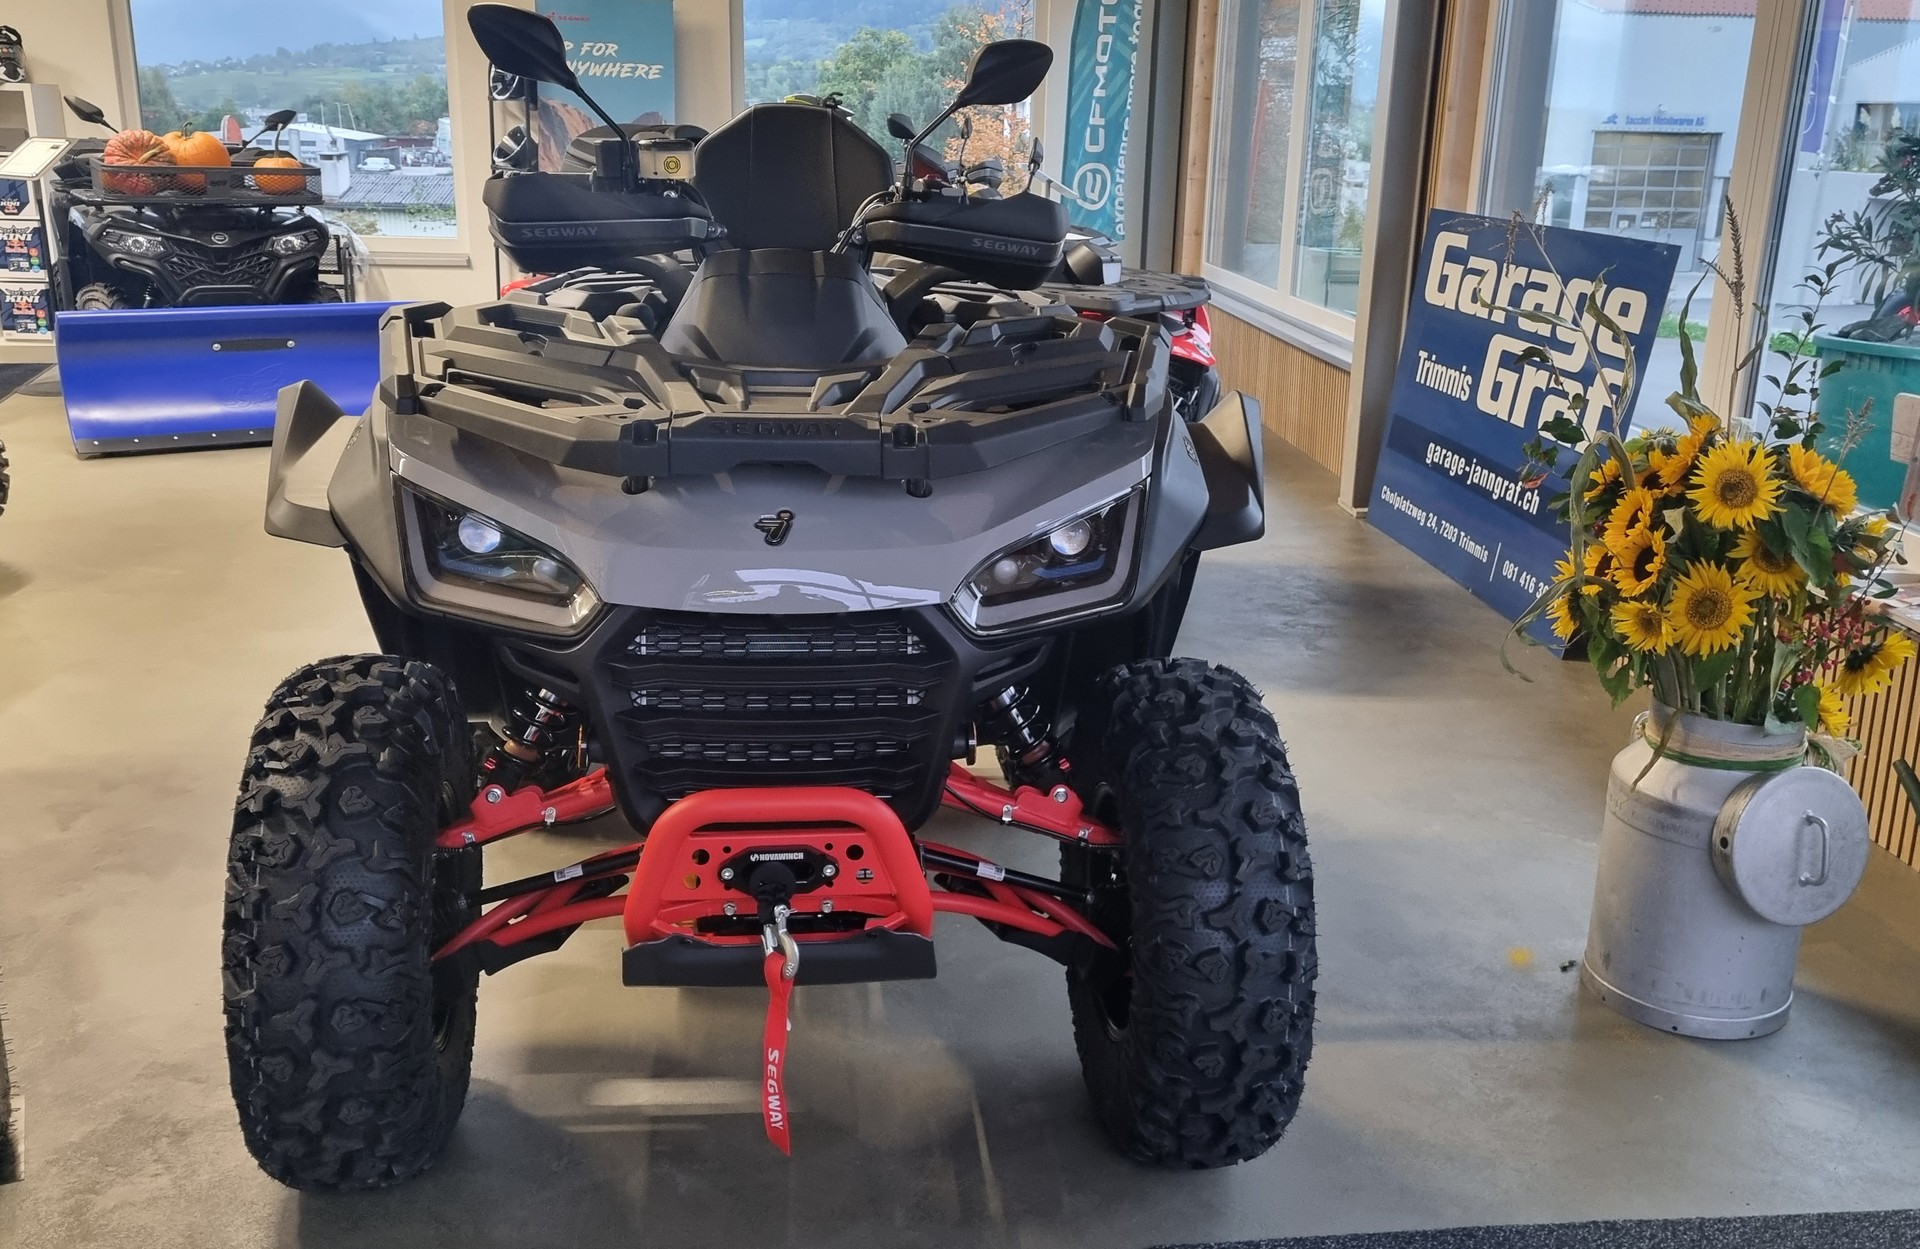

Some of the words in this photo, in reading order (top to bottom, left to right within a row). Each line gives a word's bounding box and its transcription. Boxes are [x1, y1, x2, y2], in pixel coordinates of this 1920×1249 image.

[580, 41, 619, 58] FOR
[566, 58, 664, 80] NYWHERE
[521, 226, 598, 239] SEGWAY
[971, 238, 1041, 257] SEGWAY
[5, 295, 40, 303] KINI
[1424, 230, 1648, 374] Garage
[1415, 349, 1473, 402] Trimmis
[1476, 333, 1625, 455] Graf
[710, 420, 842, 437] SEGWAY
[1425, 440, 1540, 516] garage-janngraf.ch
[1380, 484, 1427, 527] Cholplatzweg
[1426, 512, 1439, 534] 24,
[1439, 519, 1459, 543] 7203
[1459, 531, 1490, 564] Trimmis
[1502, 559, 1519, 582] 081
[1519, 571, 1537, 594] 416
[759, 851, 804, 862] NOVAWINCH
[766, 1047, 786, 1131] SEGWAY
